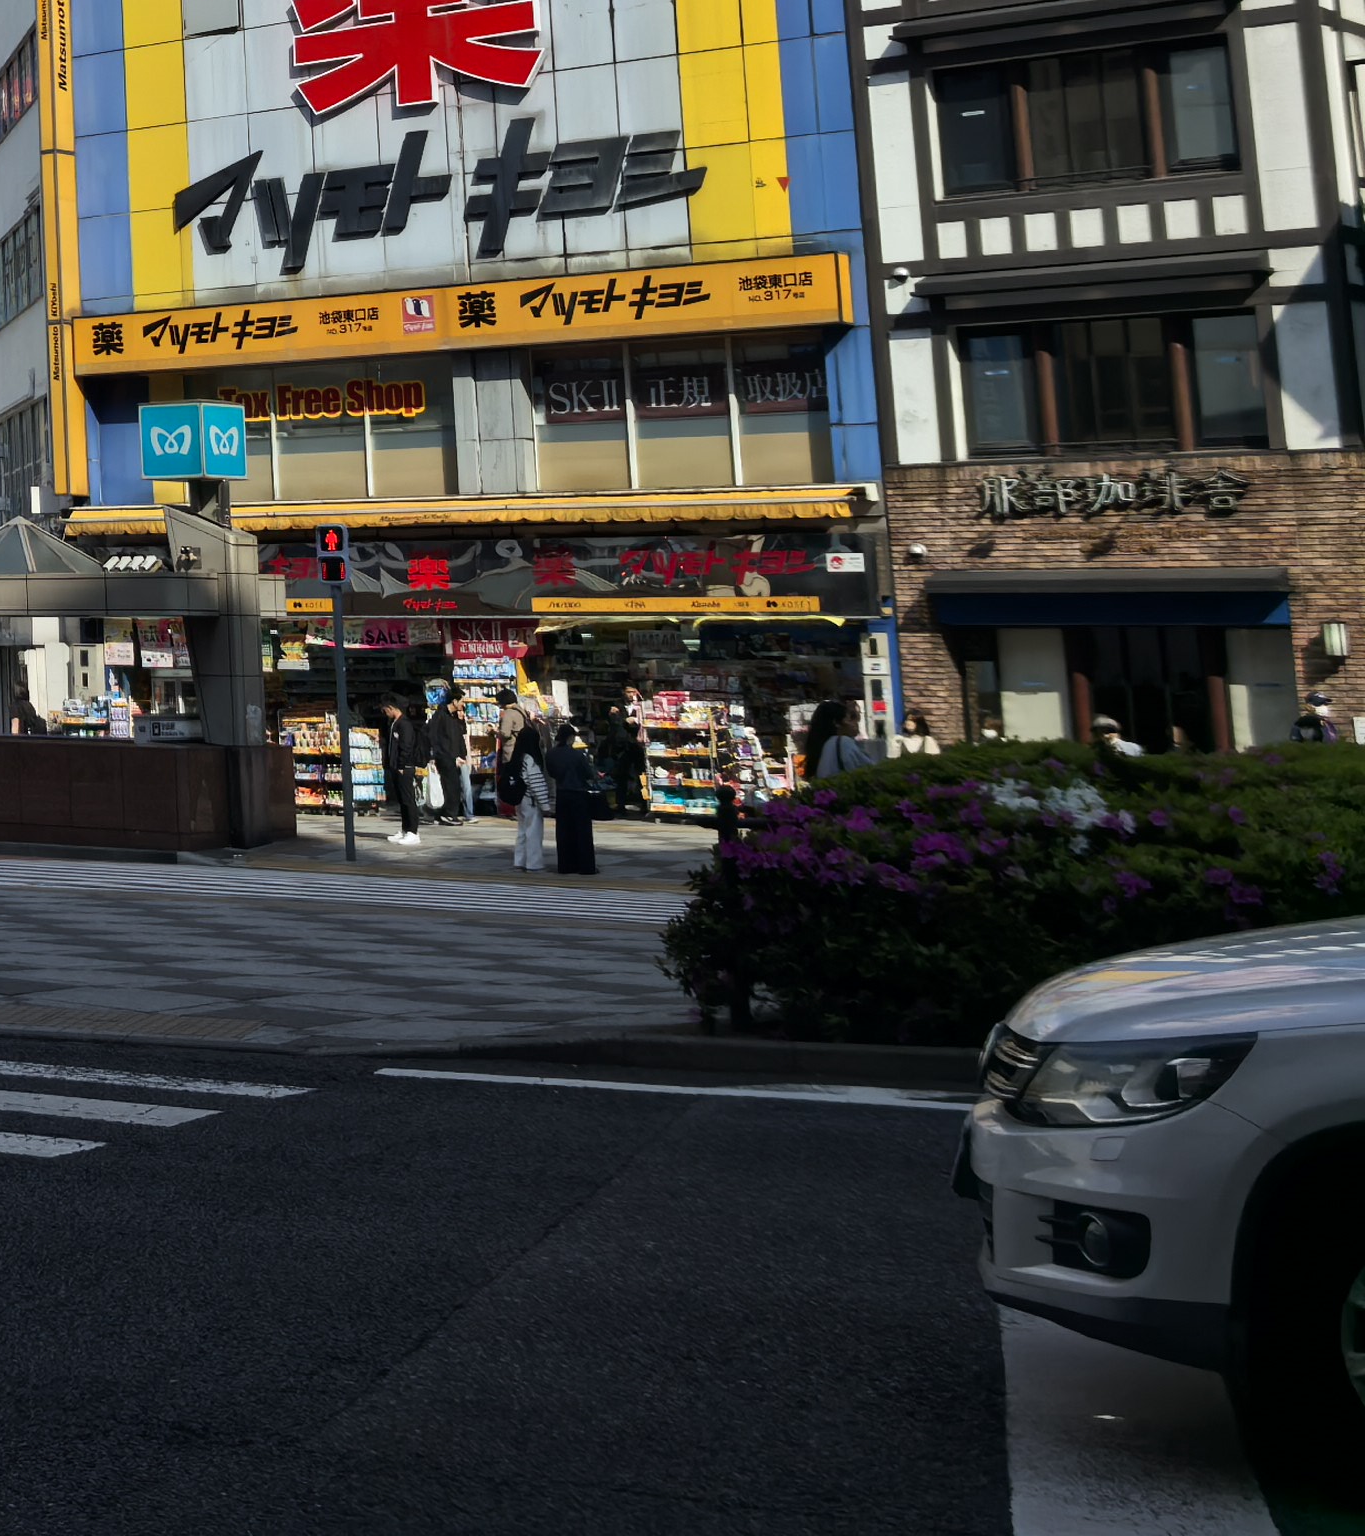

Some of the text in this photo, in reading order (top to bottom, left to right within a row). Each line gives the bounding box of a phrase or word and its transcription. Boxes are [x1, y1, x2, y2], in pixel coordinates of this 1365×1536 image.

[738, 271, 813, 292] 池袋東口店
[319, 307, 379, 324] 池袋東口店
[458, 291, 496, 328] 薬
[92, 322, 125, 356] 薬
[218, 378, 425, 422] Tax Free Shop
[646, 376, 711, 409] 正規
[746, 369, 827, 404] 取扱店
[364, 630, 407, 646] SALE
